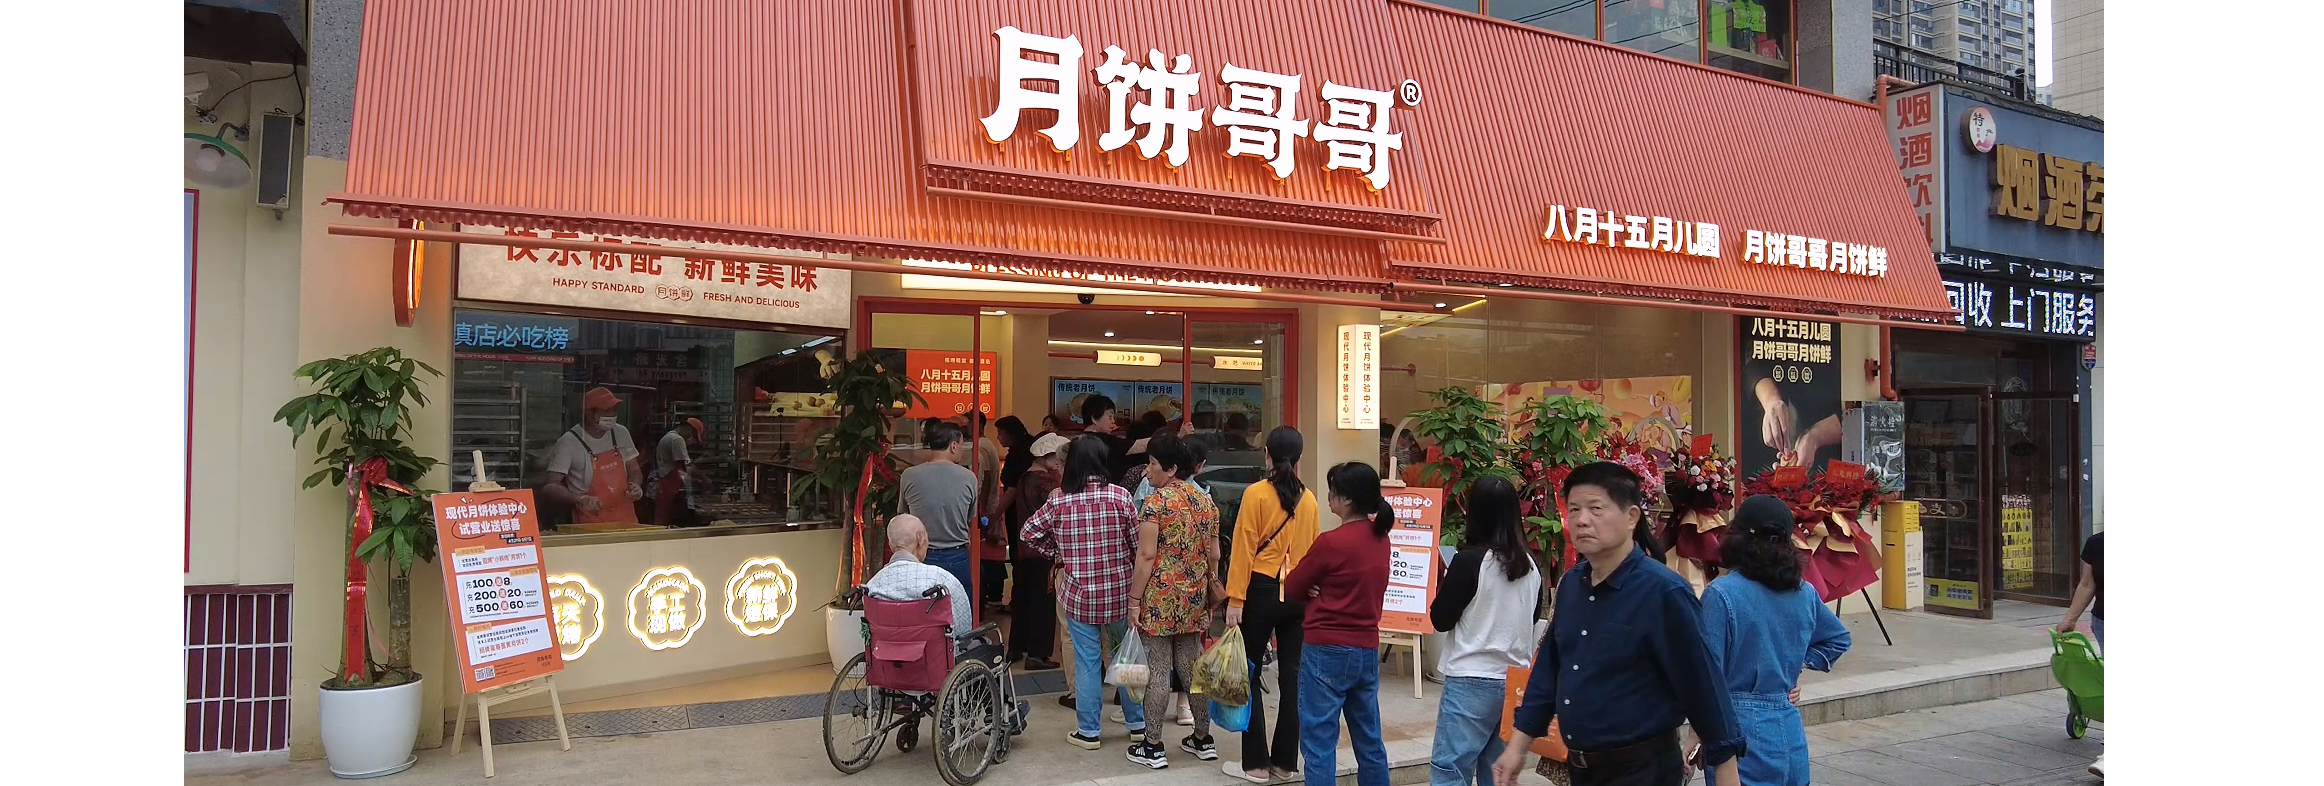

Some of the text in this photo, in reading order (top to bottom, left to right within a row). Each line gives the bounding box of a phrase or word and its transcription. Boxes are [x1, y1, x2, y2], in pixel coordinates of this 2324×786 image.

[980, 25, 1403, 190] 月饼哥哥
[1544, 204, 1720, 260] 八月十五月儿圆
[1744, 229, 1888, 279] 月饼哥哥月饼鲜
[552, 277, 588, 290] HAPPY
[591, 281, 645, 294] STANDARD
[703, 291, 732, 304] FRESH
[735, 294, 753, 305] AND
[756, 296, 800, 309] DELICIOUS
[2000, 284, 2094, 337] 上门服务
[1751, 317, 1832, 342] 八月十五月儿圆
[1752, 340, 1832, 364] 月饼哥哥月饼鲜
[1058, 383, 1096, 393] 传统老月饼
[1137, 385, 1173, 394] 传统老月饼
[445, 502, 528, 520] 现代月饼体验中心
[459, 518, 521, 536] 试营业送惊喜
